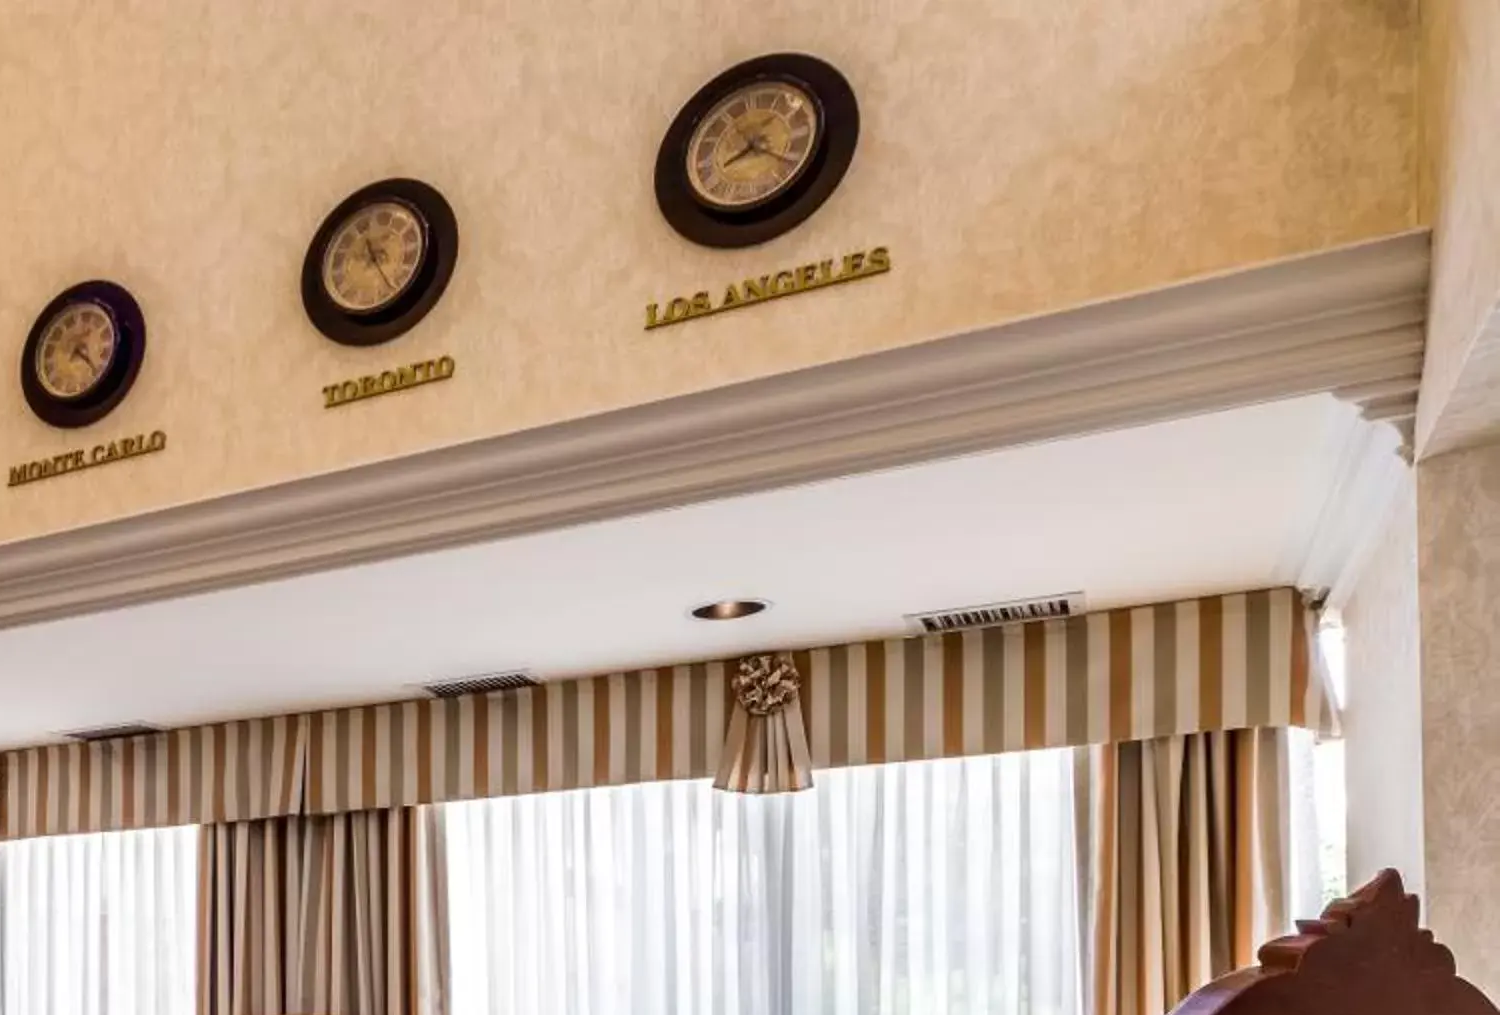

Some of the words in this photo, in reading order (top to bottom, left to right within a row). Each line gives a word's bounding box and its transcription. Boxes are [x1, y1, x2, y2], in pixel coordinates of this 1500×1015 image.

[644, 292, 712, 328] LOS
[722, 247, 890, 309] ANGELES
[322, 356, 455, 407] TORONTO
[8, 450, 86, 485] MONTE
[92, 430, 167, 463] CARLO
